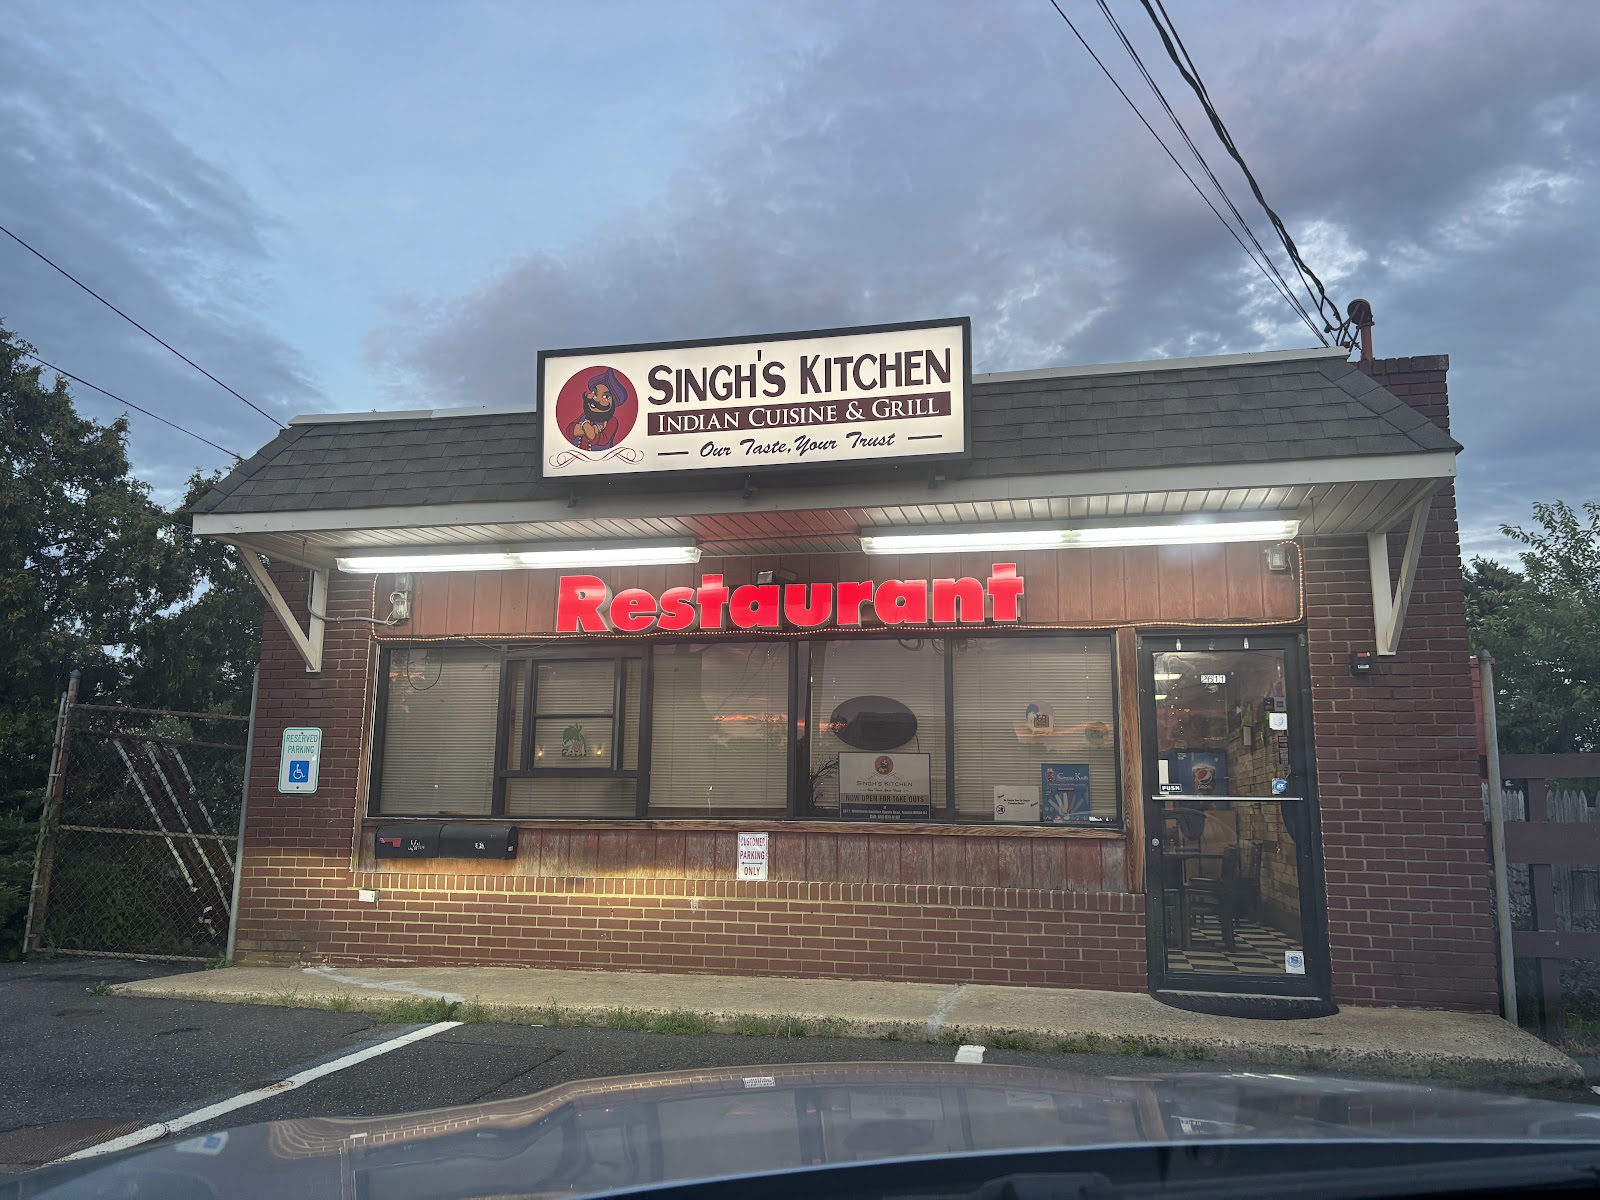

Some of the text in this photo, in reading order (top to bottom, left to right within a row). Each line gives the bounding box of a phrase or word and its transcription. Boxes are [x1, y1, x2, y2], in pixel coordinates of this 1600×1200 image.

[647, 347, 951, 406] SINGH'S KITCHEN
[658, 397, 940, 434] INDIAN CUISINE & GRILL
[699, 440, 732, 458] Our
[845, 430, 897, 449] Trust
[556, 562, 1025, 633] Restaurant
[1201, 675, 1224, 684] 2611
[285, 734, 318, 743] RESERVED
[287, 745, 315, 754] PARKING
[892, 795, 908, 803] TAKE
[740, 837, 766, 847] CUSTOMER
[739, 850, 765, 860] PARKING
[743, 866, 761, 876] ONLY
